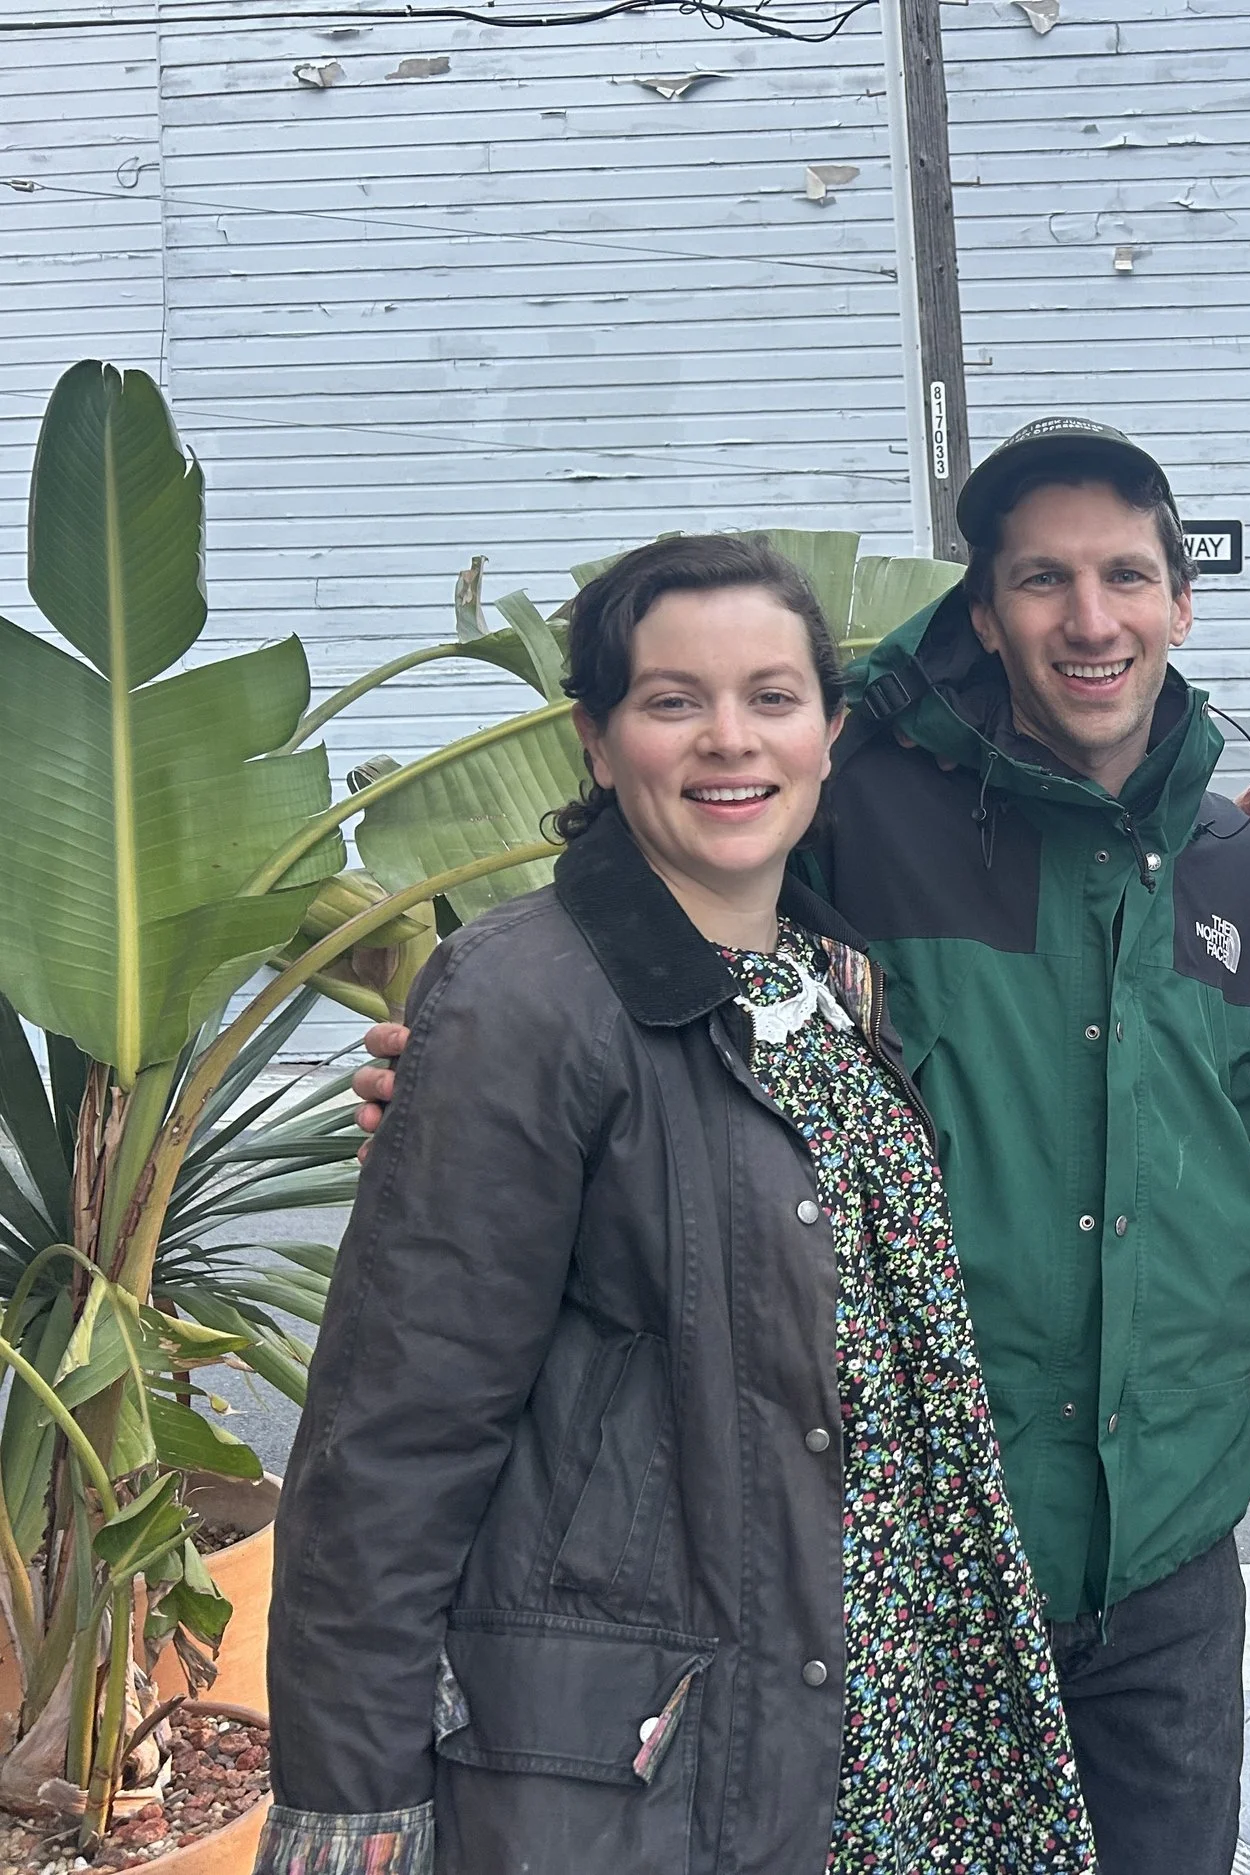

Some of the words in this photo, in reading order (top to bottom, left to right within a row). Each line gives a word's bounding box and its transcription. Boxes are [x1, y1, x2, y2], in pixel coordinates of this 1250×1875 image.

[934, 386, 945, 474] 817033
[1195, 921, 1230, 950] NORTH
[1212, 914, 1233, 936] THE
[1207, 940, 1230, 964] FACE
